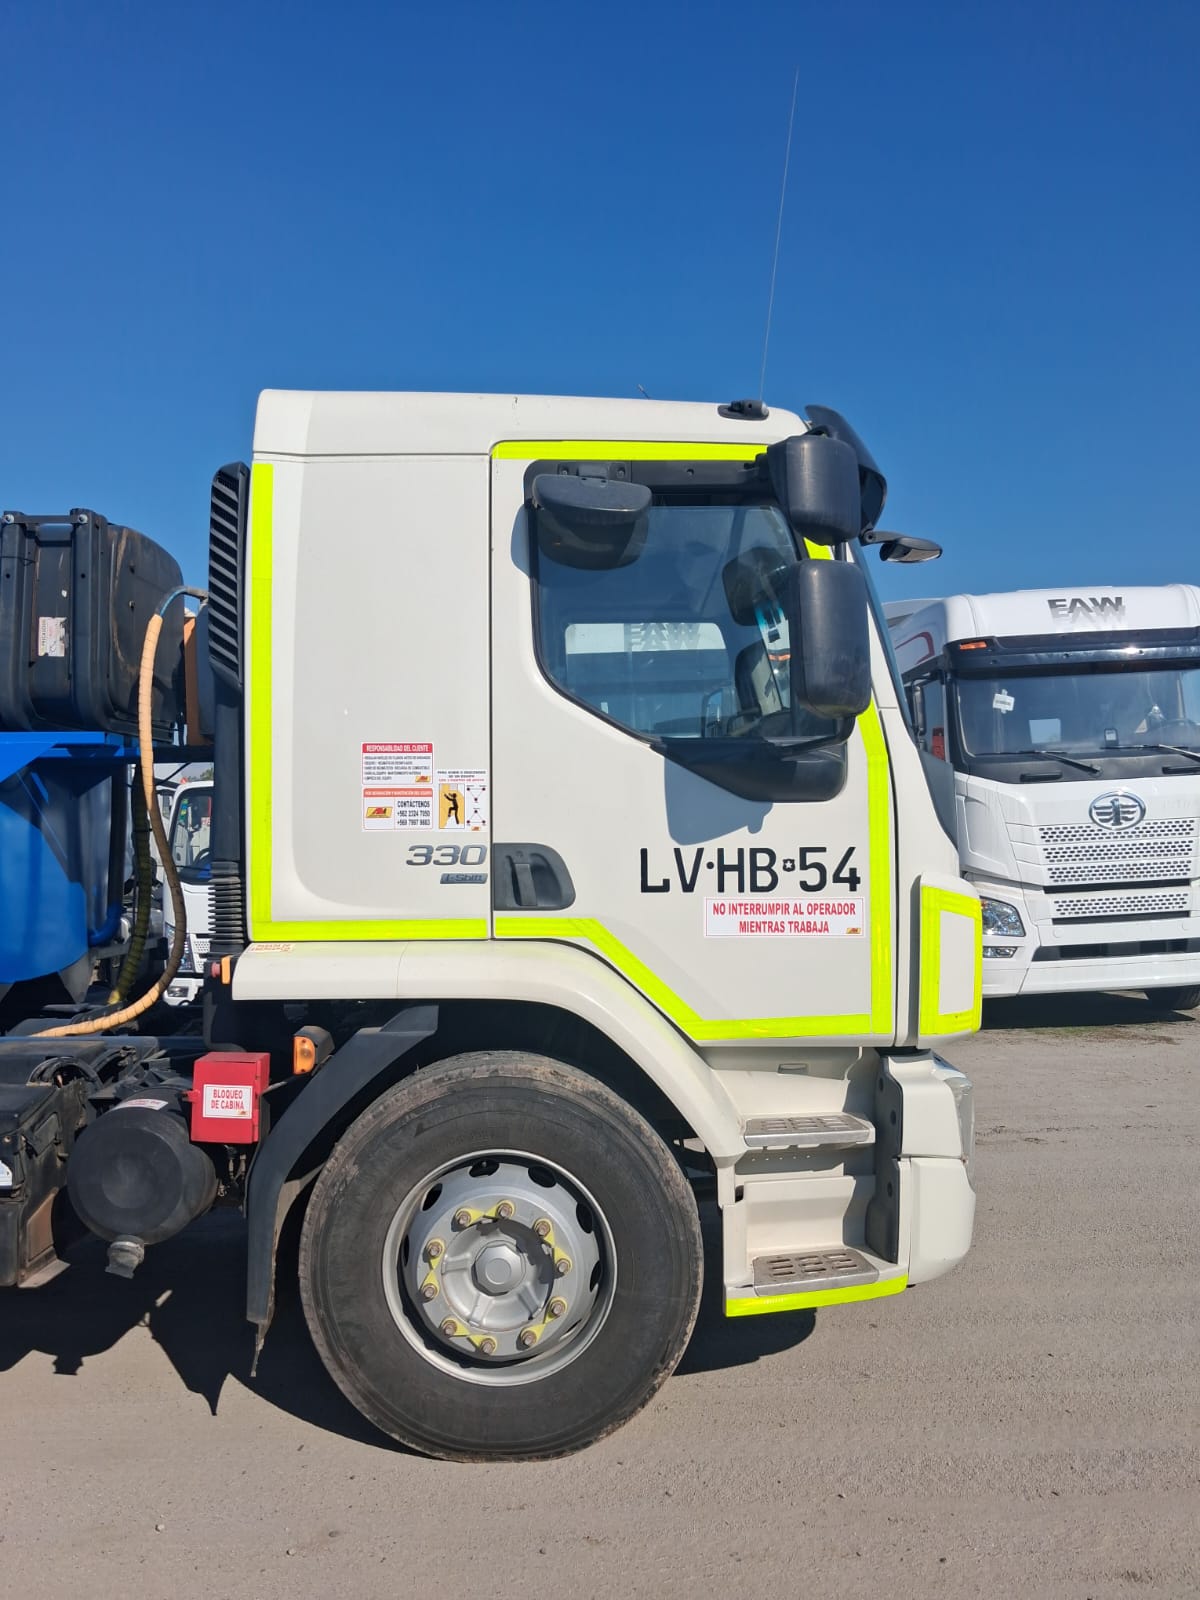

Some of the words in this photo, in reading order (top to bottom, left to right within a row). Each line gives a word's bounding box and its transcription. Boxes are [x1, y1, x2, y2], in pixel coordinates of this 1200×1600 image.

[366, 744, 403, 752] RESPONSABILIDAD
[403, 744, 411, 752] DEL
[411, 744, 429, 752] CLIENTE
[405, 844, 488, 866] 330
[712, 902, 726, 916] NO
[728, 902, 790, 916] INTERRUMPIR
[792, 902, 804, 916] AL
[806, 902, 856, 916] OPERADOR
[739, 920, 785, 933] MIENTRAS
[788, 920, 829, 933] TRABAJA
[213, 1089, 243, 1099] BLOQUEO
[211, 1100, 220, 1109] DE
[220, 1100, 244, 1110] CABINA
